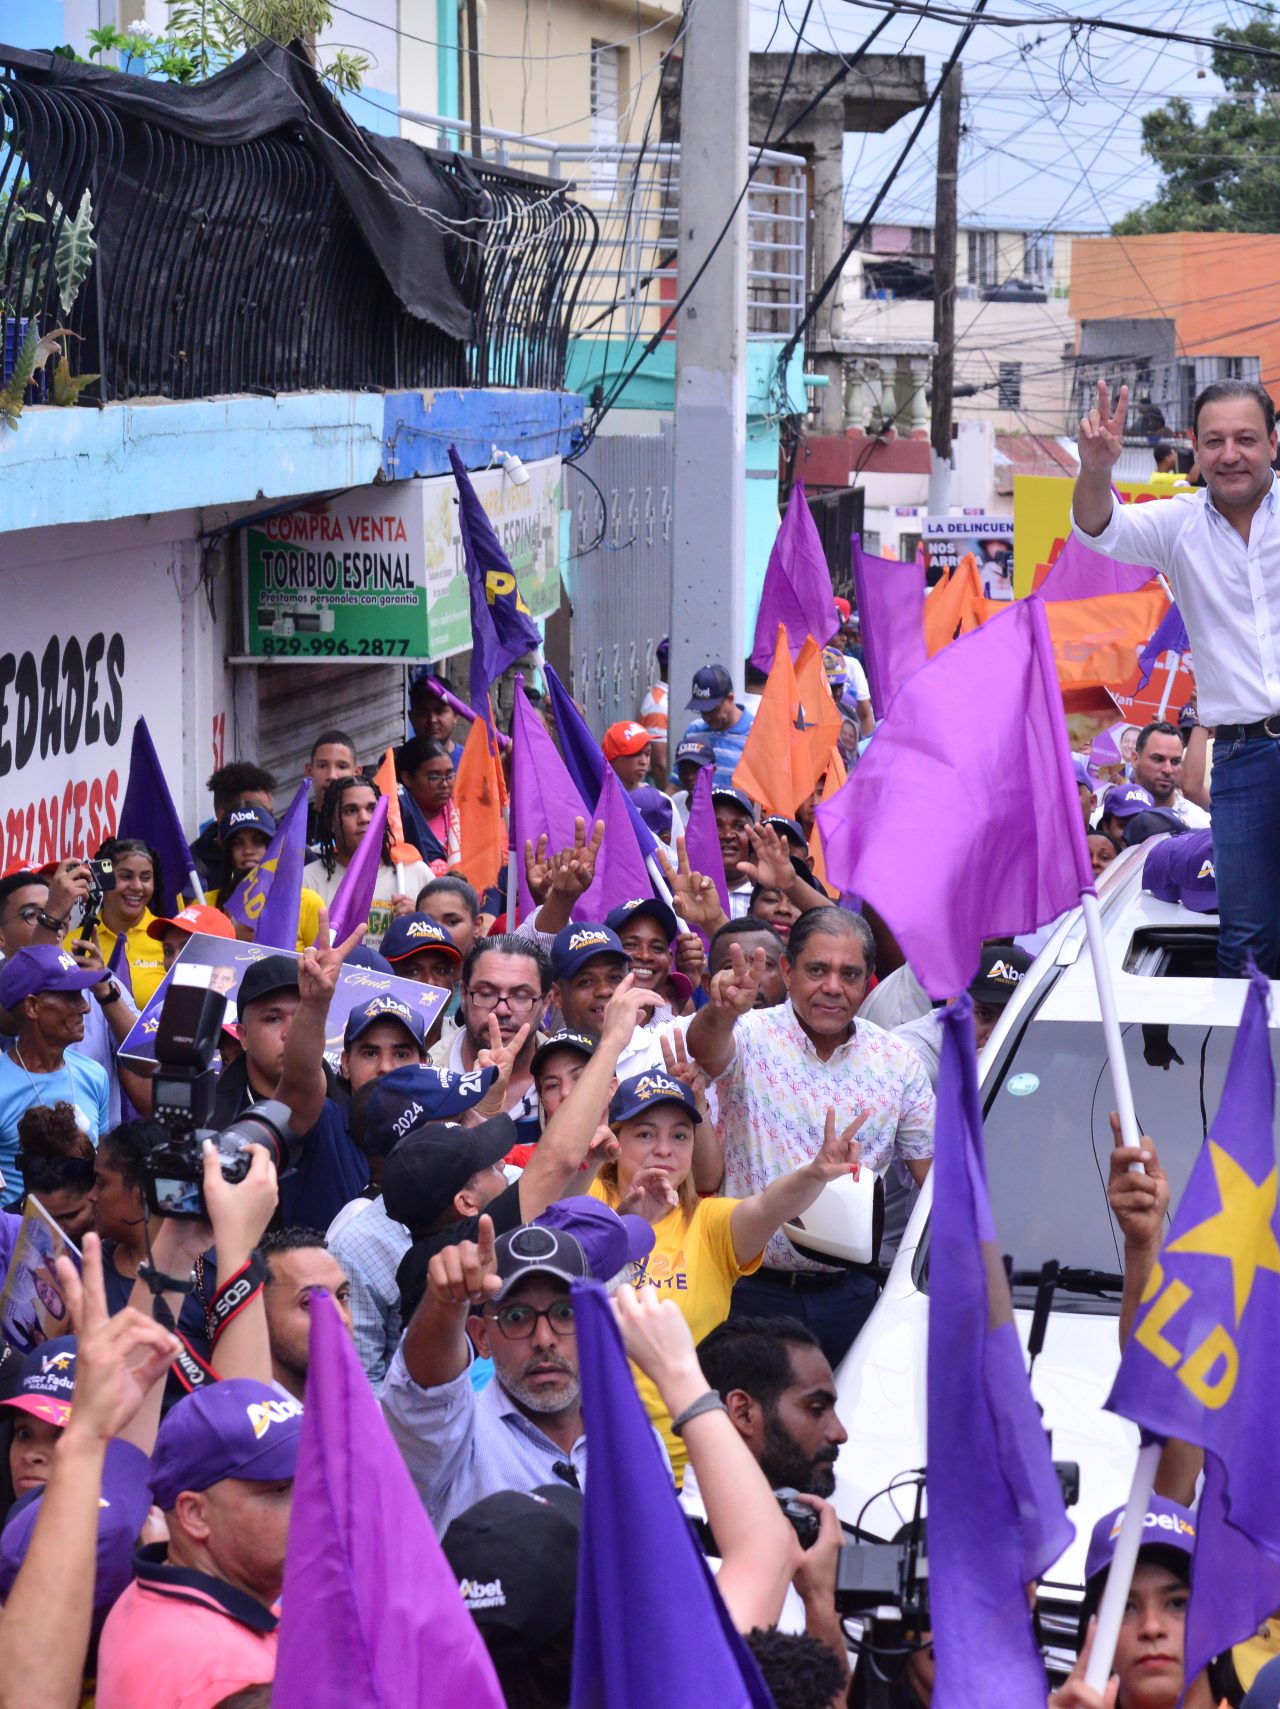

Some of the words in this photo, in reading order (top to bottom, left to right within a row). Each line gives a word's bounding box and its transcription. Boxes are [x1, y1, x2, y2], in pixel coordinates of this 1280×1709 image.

[266, 513, 344, 543] COMPRA
[348, 515, 408, 543] VENTA
[927, 523, 945, 533] LA
[928, 542, 956, 555] NOS
[261, 551, 338, 589] TORIBIO
[342, 552, 415, 590] ESPINAL
[310, 592, 359, 605] personales
[360, 594, 377, 604] con
[262, 636, 410, 656] 829-996-2877
[407, 920, 446, 940] Abel
[568, 929, 611, 951] Abel
[363, 996, 413, 1018] Abel
[633, 1074, 685, 1097] Abel
[392, 1101, 424, 1138] 2024
[215, 1279, 251, 1318] EOS
[458, 1577, 504, 1599] Abel
